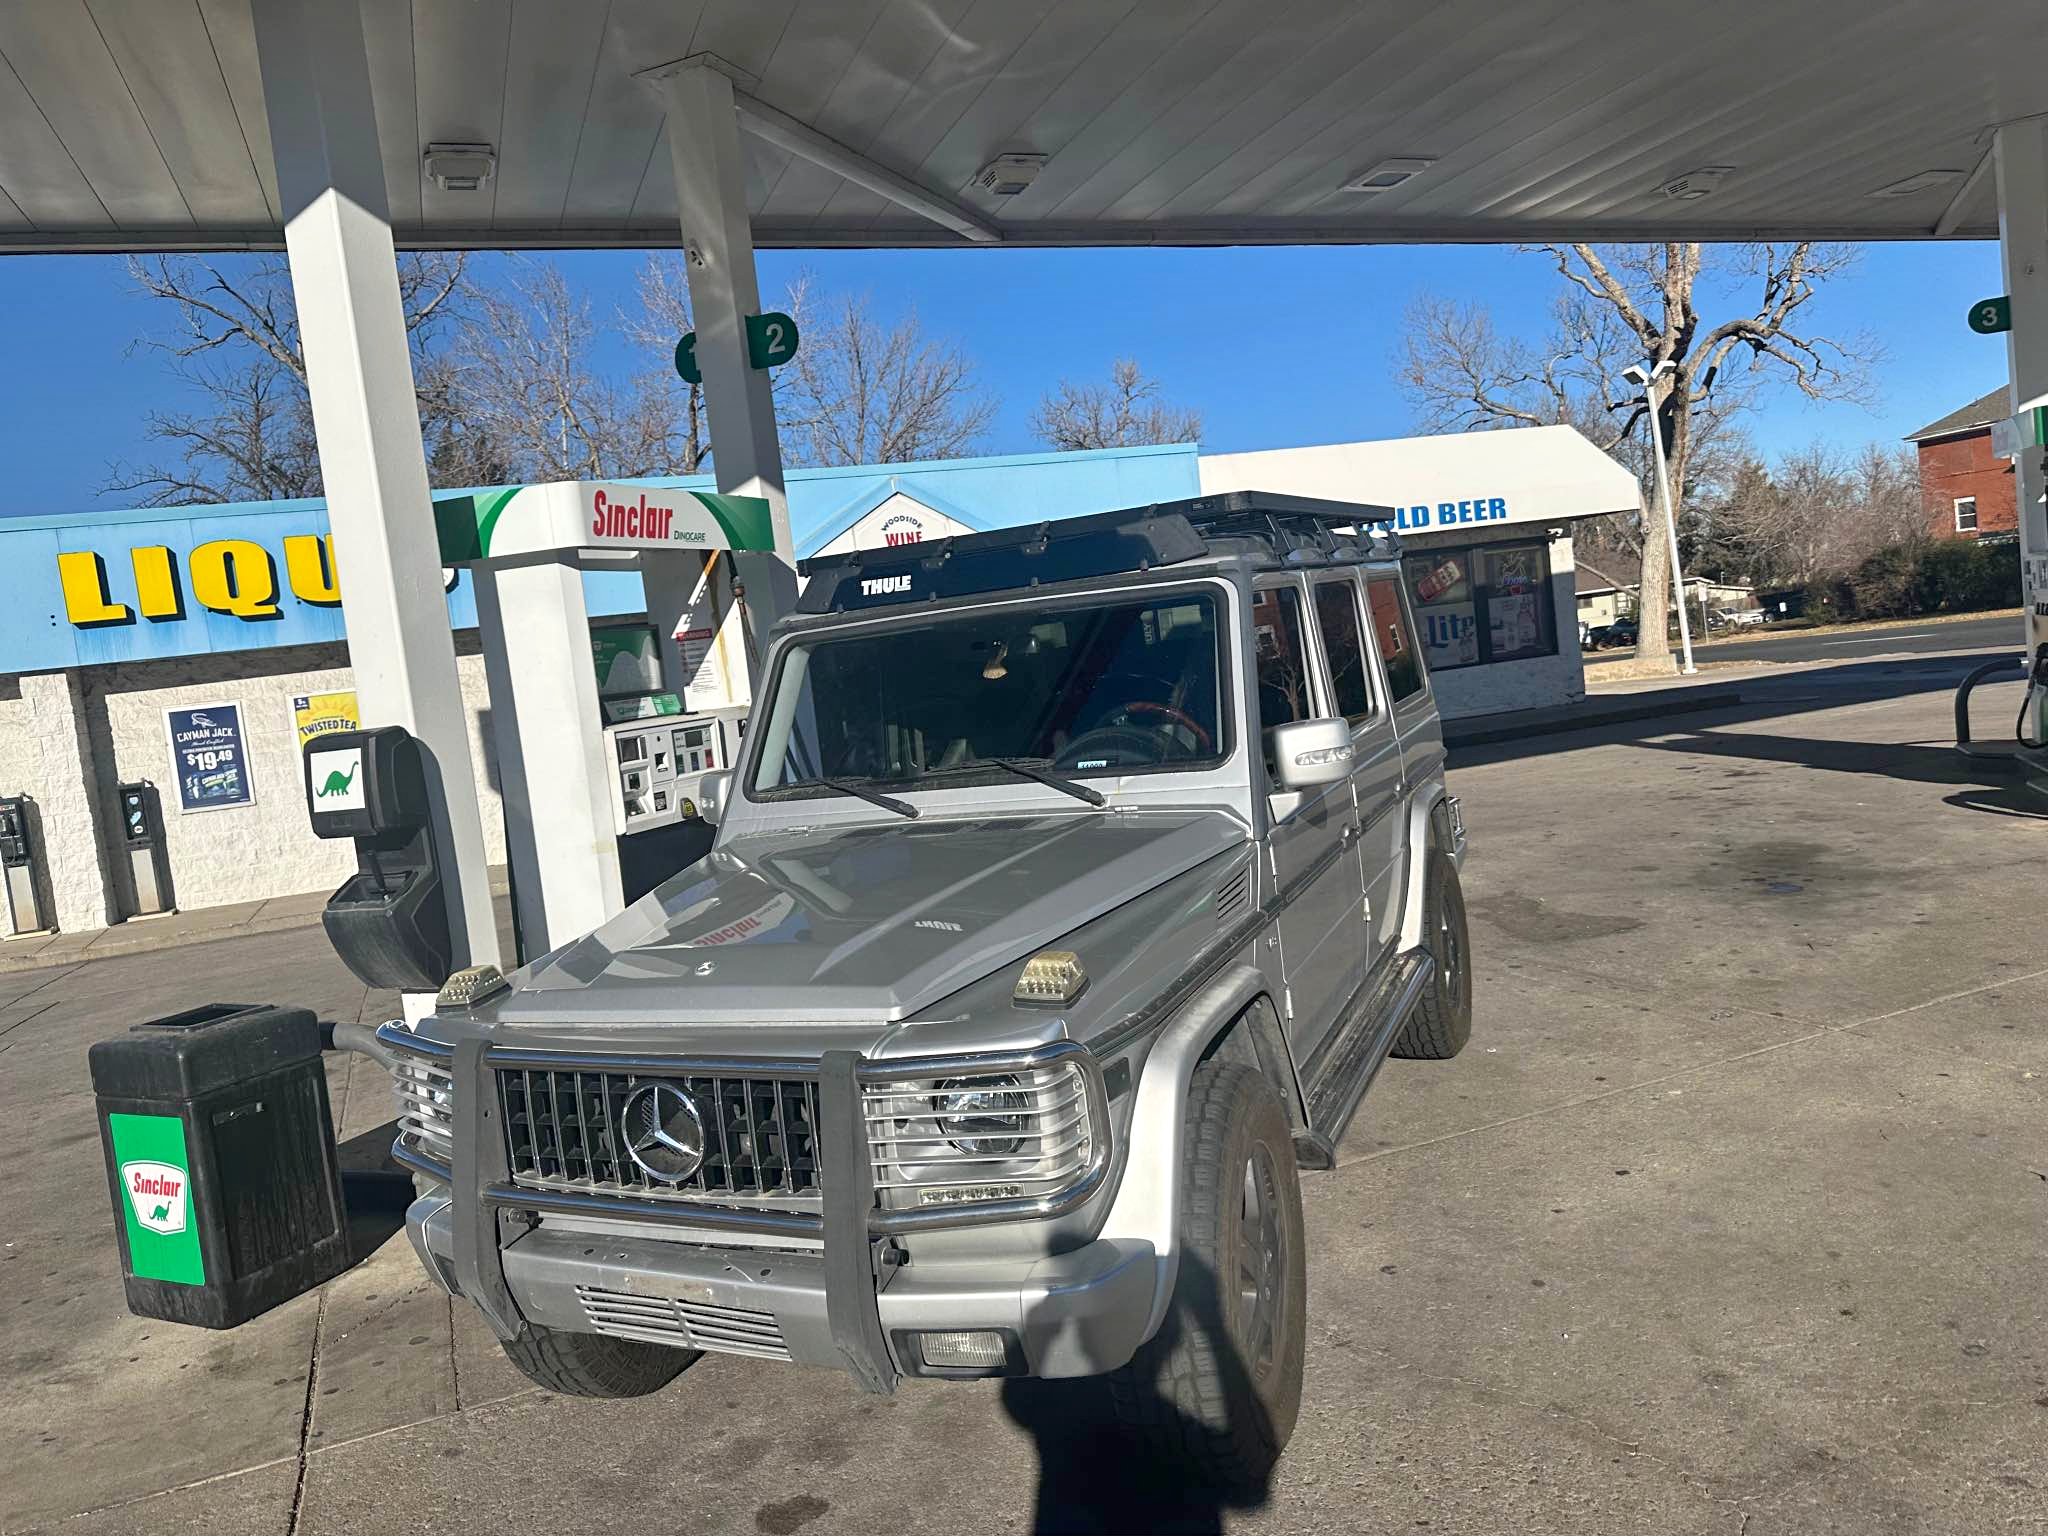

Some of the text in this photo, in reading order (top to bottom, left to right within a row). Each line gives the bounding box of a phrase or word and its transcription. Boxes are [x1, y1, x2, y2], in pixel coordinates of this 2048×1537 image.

[1982, 307, 1997, 326] 3
[766, 323, 785, 354] 2
[593, 489, 673, 539] Sinclair
[1438, 498, 1507, 525] BEER
[881, 515, 923, 531] WOODSIDE
[885, 531, 923, 547] WINE
[57, 535, 343, 626] LIQU
[861, 574, 912, 596] THULE
[176, 727, 233, 742] CAYMAN JACK
[300, 718, 357, 736] TWISTED TEA
[187, 749, 233, 771] $19.49
[133, 1171, 181, 1198] Sinclair
